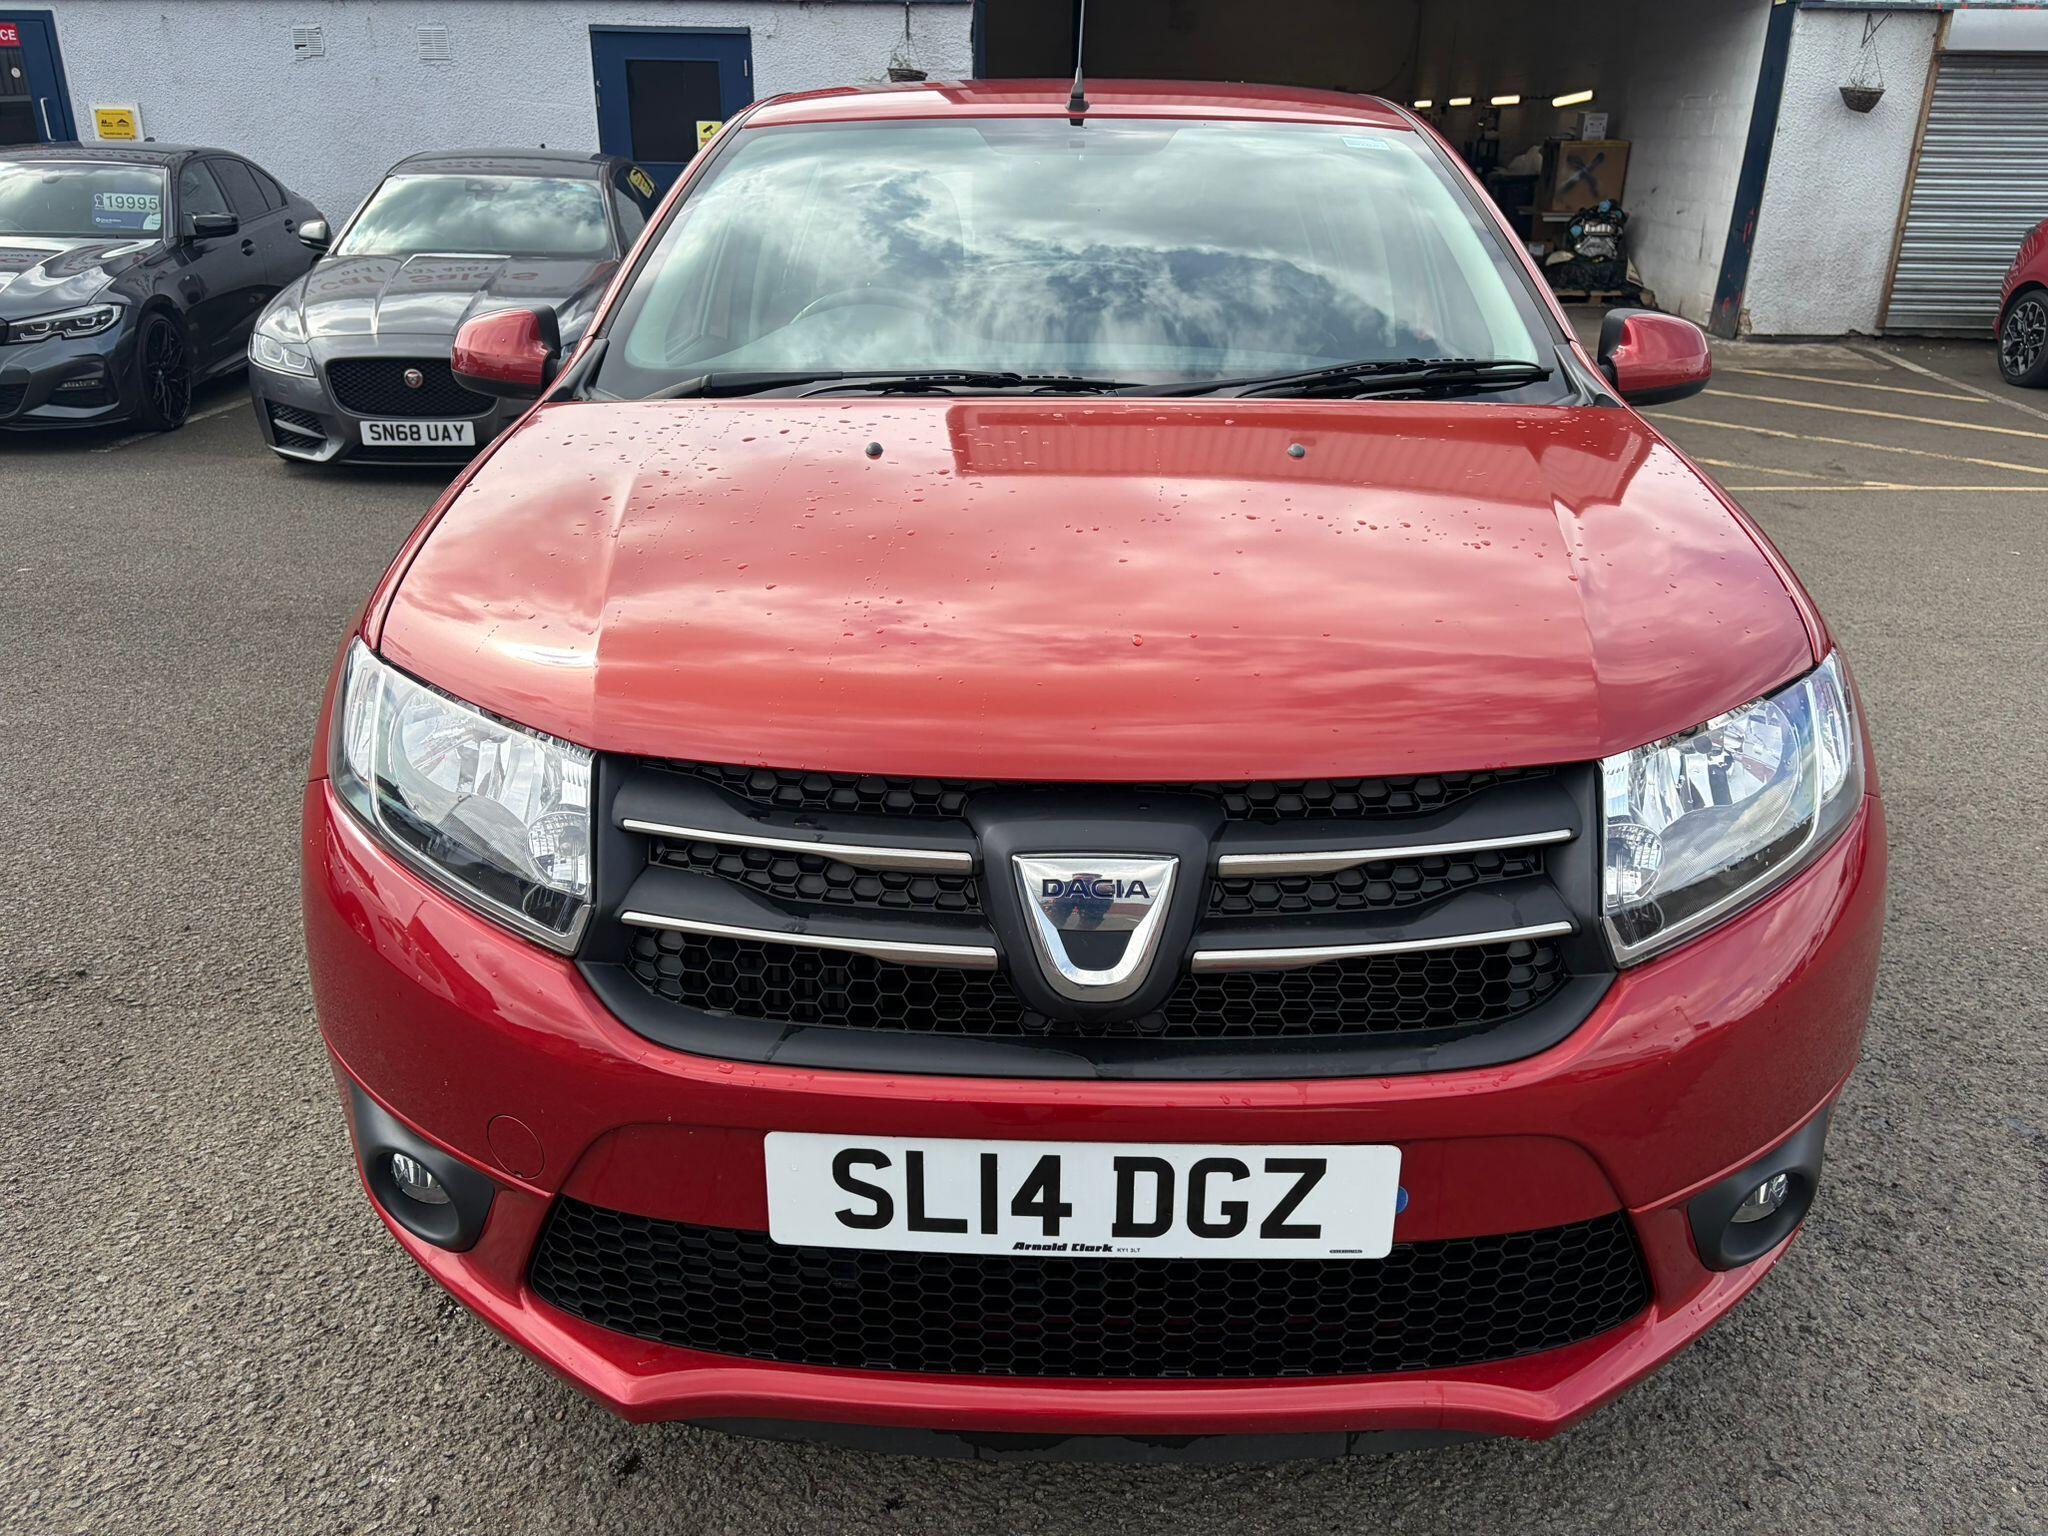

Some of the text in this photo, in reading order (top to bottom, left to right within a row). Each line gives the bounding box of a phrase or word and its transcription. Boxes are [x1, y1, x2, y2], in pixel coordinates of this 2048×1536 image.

[94, 193, 159, 211] £19995
[369, 424, 464, 441] SN68 UAY
[1042, 878, 1150, 899] DACIA
[832, 1148, 1327, 1239] SL14 DGZ
[1012, 1241, 1067, 1252] Arnold
[1071, 1243, 1113, 1253] Clark
